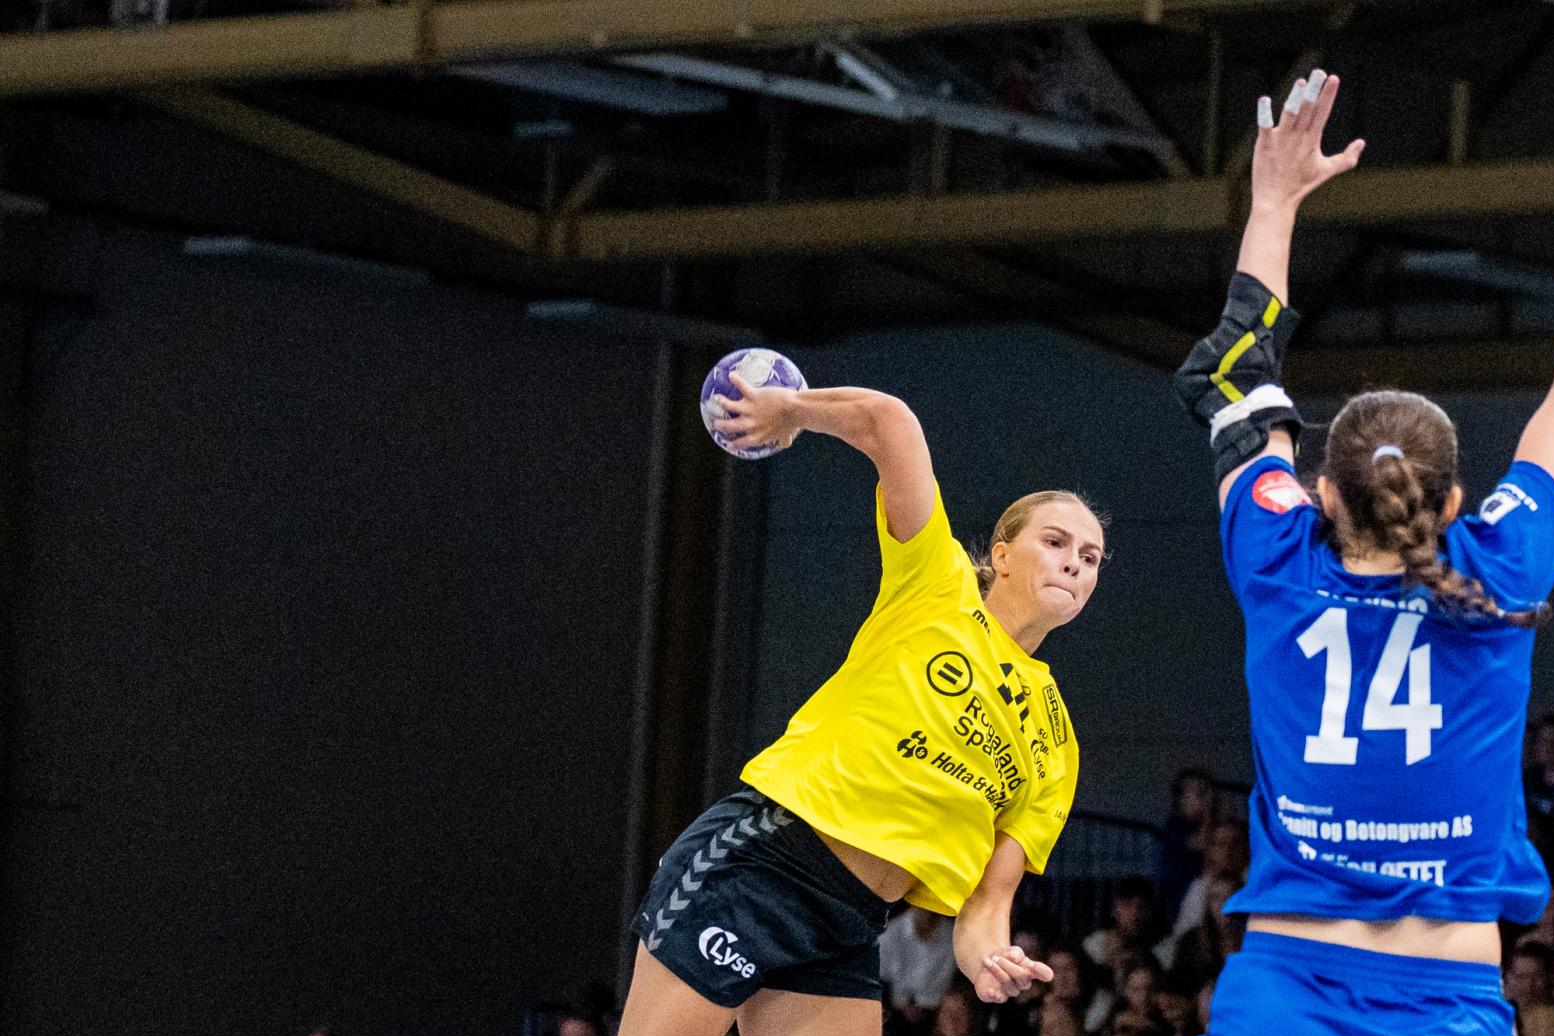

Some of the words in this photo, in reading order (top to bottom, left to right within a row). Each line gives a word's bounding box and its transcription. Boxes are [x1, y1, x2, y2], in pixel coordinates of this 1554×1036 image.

[1296, 607, 1443, 766] 14
[930, 751, 974, 785] Holta
[973, 776, 987, 792] &
[1452, 815, 1473, 838] AS
